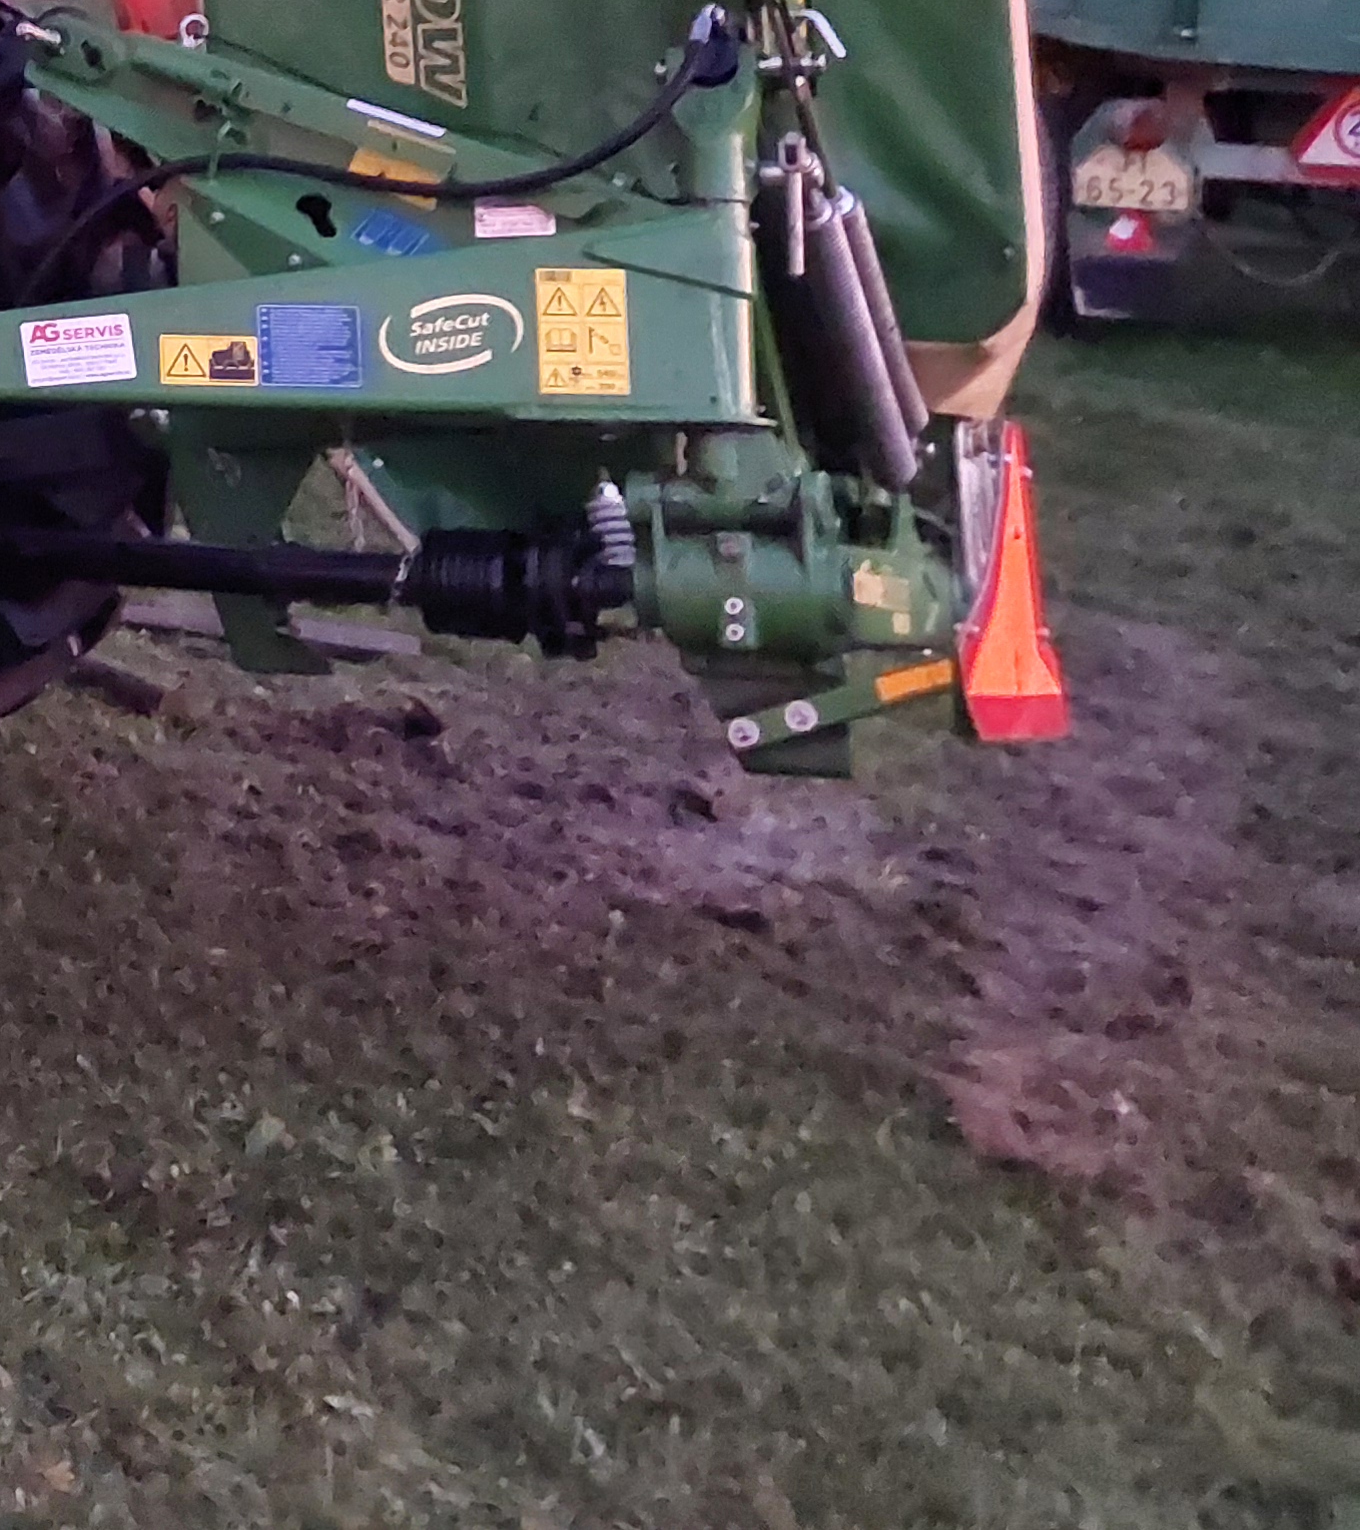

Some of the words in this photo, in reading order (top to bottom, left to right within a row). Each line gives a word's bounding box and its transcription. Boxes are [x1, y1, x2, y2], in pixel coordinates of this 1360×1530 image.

[29, 323, 60, 343] AG
[62, 324, 124, 340] SERVIS
[409, 312, 490, 337] SafeCut
[415, 332, 483, 355] INSIDE
